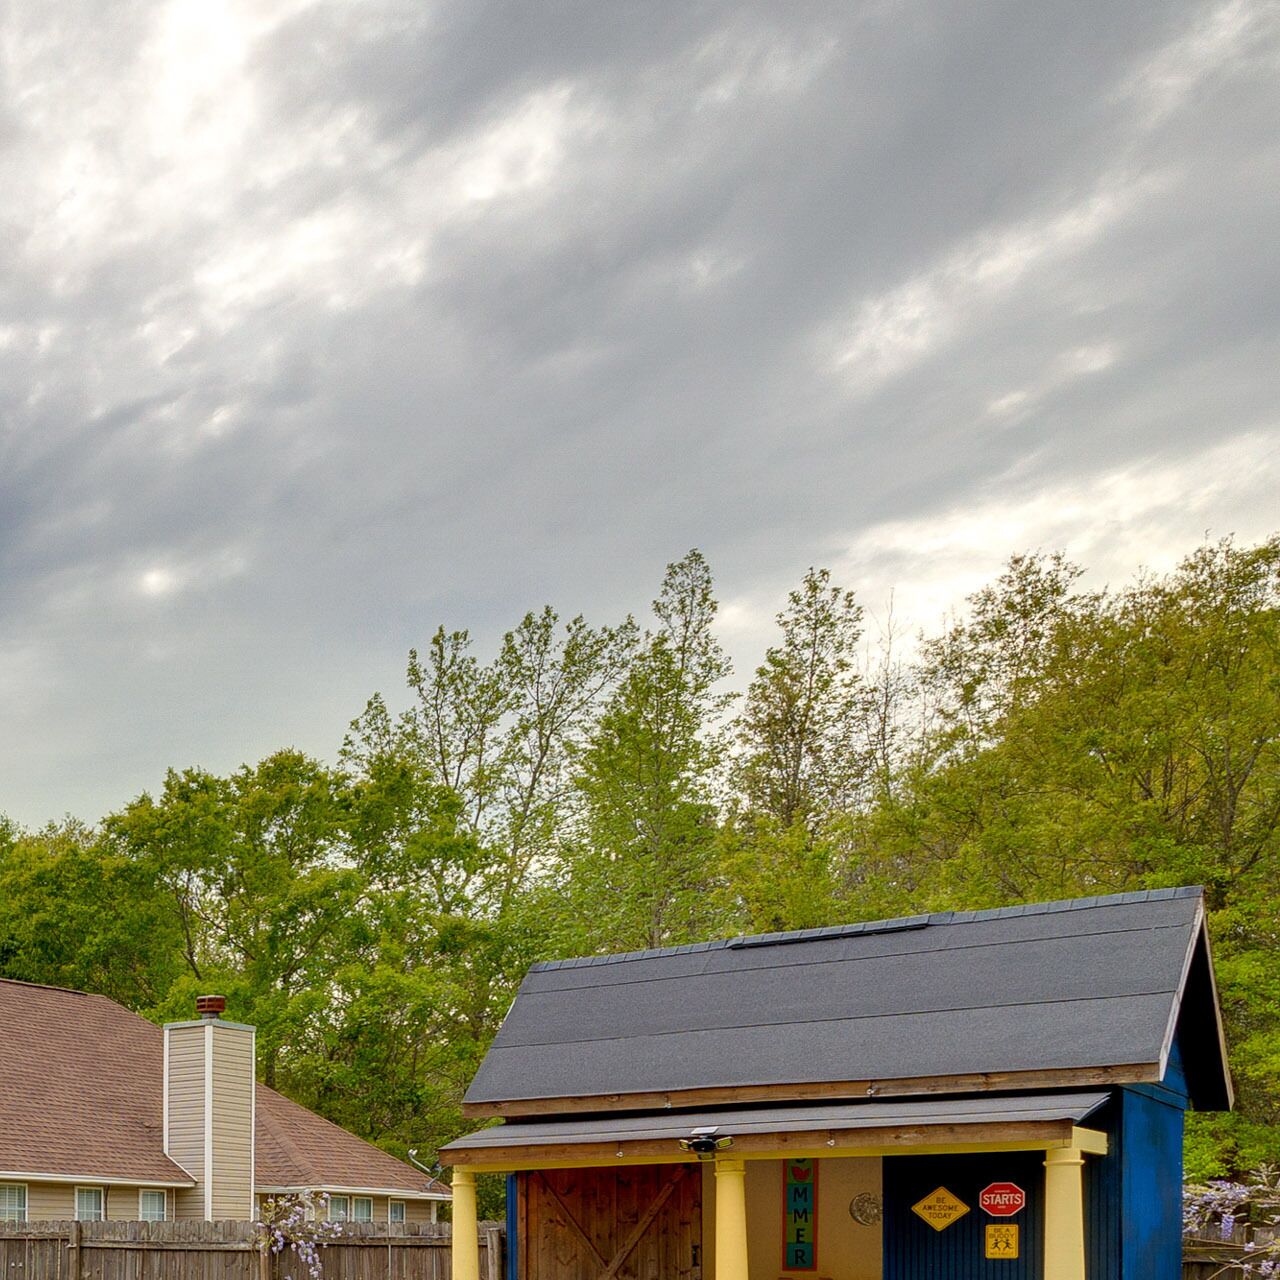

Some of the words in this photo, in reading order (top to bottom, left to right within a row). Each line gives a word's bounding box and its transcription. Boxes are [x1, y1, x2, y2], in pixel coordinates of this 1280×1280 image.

[983, 1194, 1022, 1205] STARTS
[793, 1157, 808, 1265] MMER
[922, 1204, 958, 1212] AWESOME
